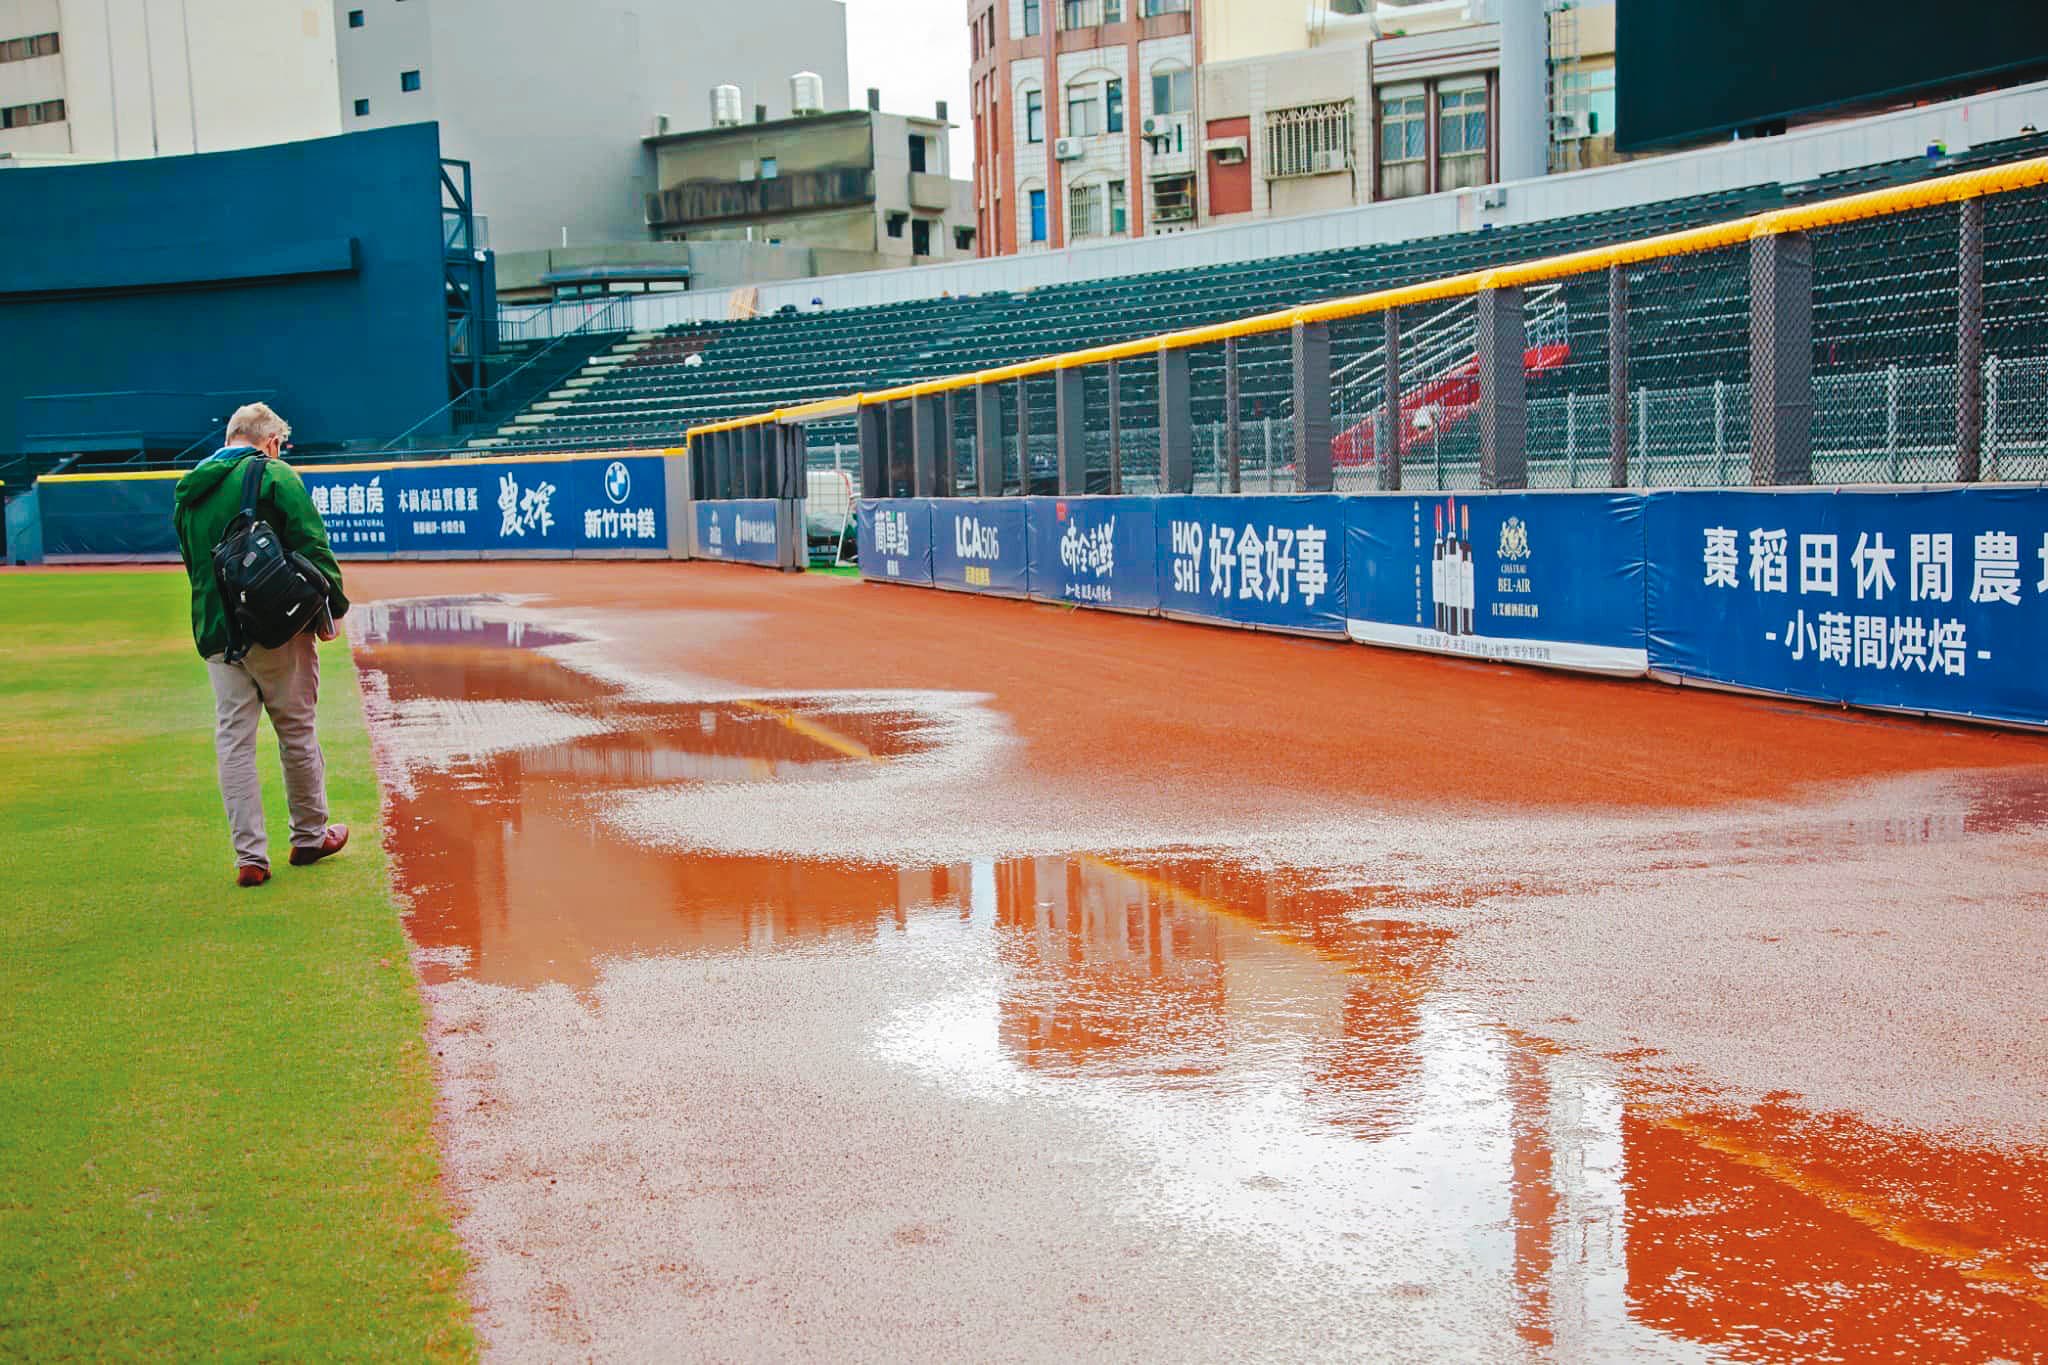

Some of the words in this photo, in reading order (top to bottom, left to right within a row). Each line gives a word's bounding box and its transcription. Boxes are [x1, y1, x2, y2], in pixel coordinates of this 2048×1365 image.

[353, 519, 385, 529] NATURAL
[584, 508, 656, 539] 新竹中鎂
[955, 515, 1000, 561] LCA506
[1209, 523, 1329, 606] 好食好事
[1498, 577, 1531, 593] BEL-AIR
